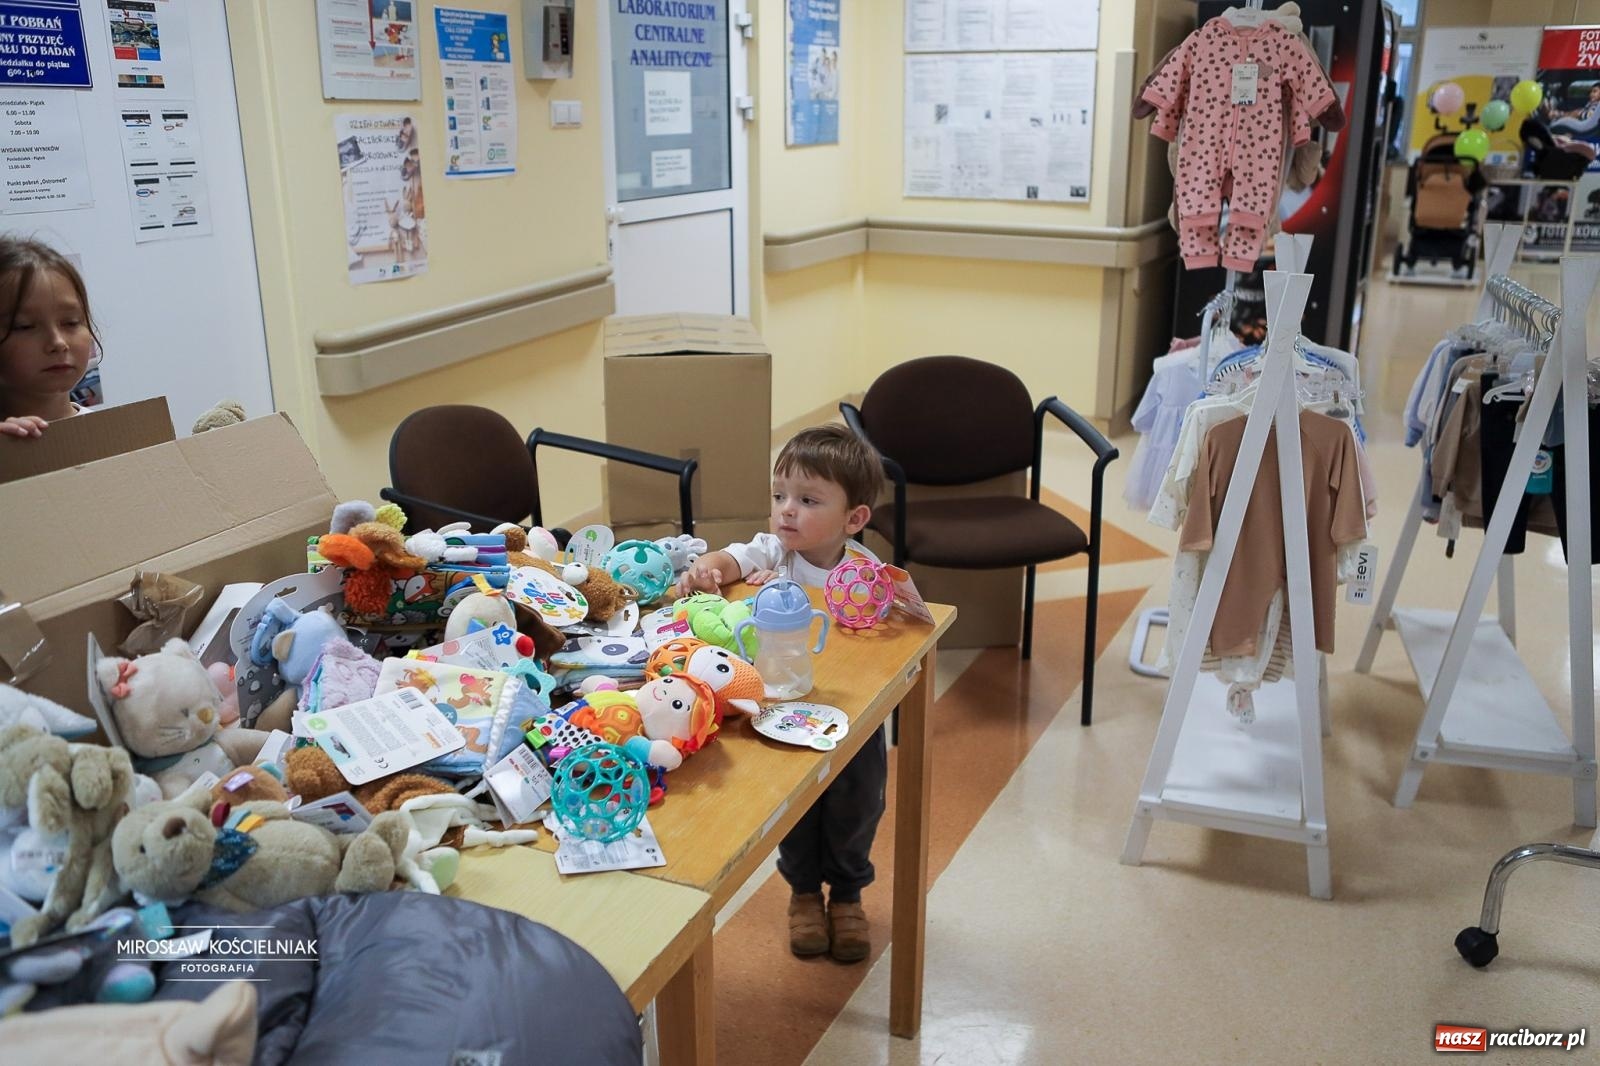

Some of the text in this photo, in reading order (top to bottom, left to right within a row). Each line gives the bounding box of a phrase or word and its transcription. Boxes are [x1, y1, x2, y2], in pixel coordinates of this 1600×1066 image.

[618, 0, 716, 20] LABORATORIUM
[10, 16, 62, 28] POBRAŃ
[634, 24, 705, 43] CENTRALNE
[18, 34, 63, 46] PRZYJĘĆ
[22, 45, 37, 54] DO
[40, 46, 75, 56] BADAŃ
[36, 60, 45, 68] do
[630, 49, 713, 67] ANALITYCZNE
